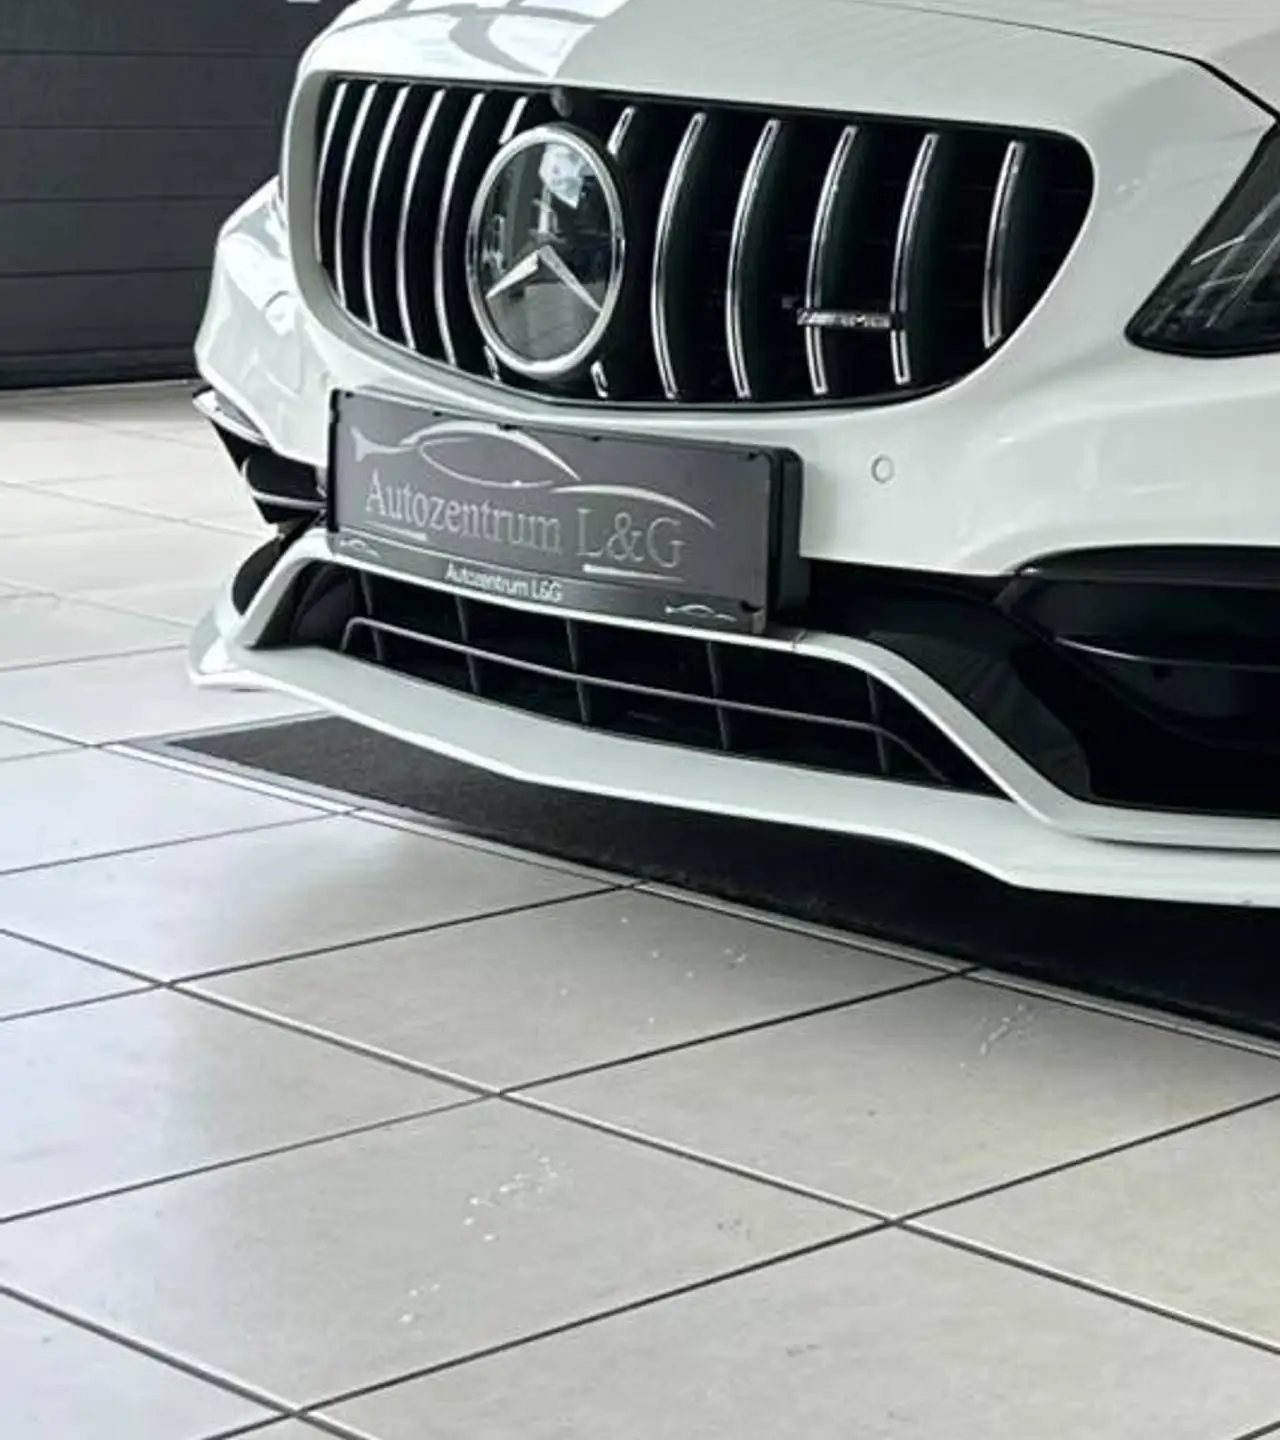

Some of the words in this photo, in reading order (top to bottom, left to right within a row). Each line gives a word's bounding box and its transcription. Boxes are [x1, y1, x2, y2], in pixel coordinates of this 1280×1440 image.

[365, 468, 564, 555] Autozentrum
[576, 508, 686, 568] L&G
[444, 561, 529, 598] Autozentrum
